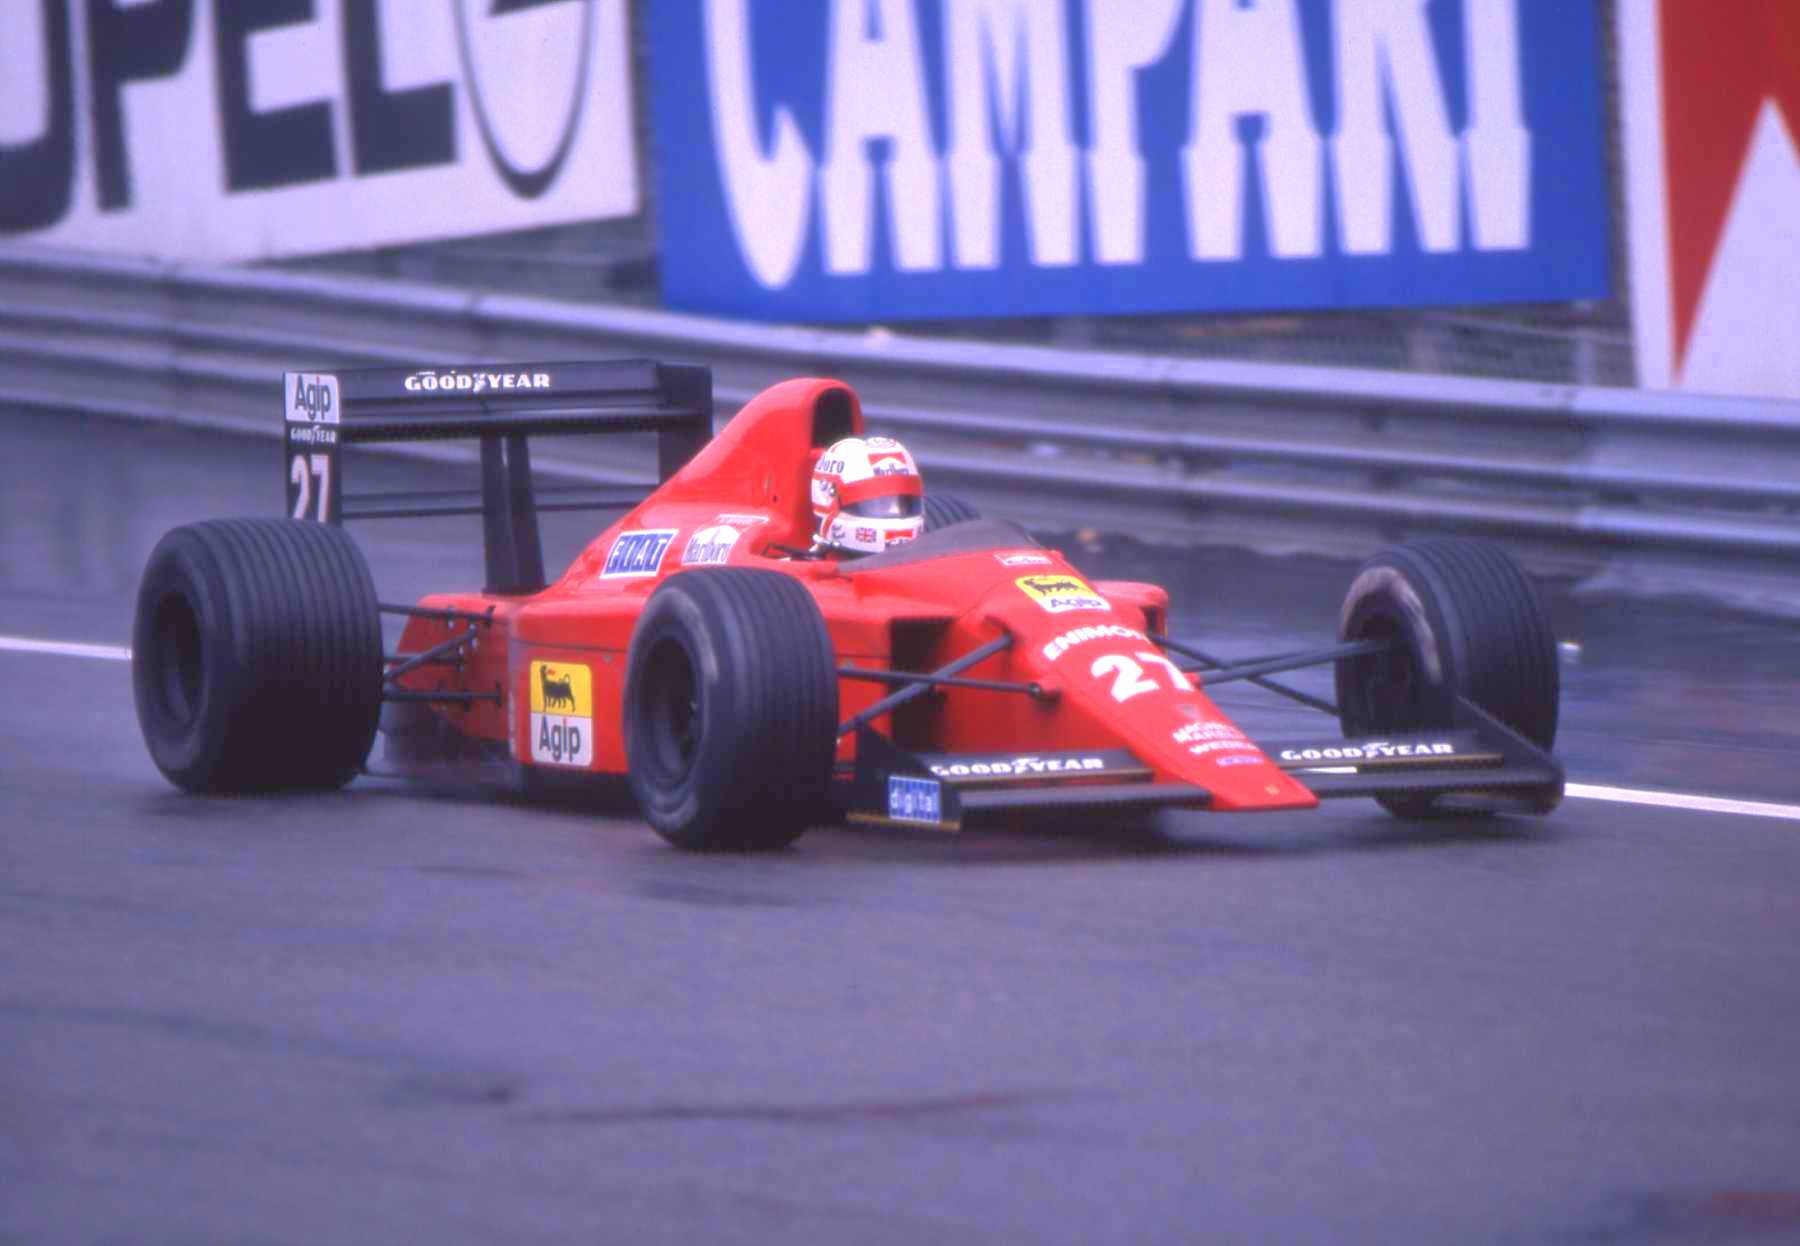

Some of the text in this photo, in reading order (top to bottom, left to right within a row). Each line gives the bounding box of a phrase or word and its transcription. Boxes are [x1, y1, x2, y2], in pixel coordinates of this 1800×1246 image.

[702, 0, 1532, 290] CAMPARI
[294, 376, 332, 420] Agip
[404, 371, 551, 393] GOODYEAR
[290, 425, 337, 445] GOODYEAR
[291, 454, 330, 523] 27
[609, 538, 669, 568] FIAT
[1043, 625, 1151, 661] ENIMO
[1090, 651, 1194, 703] 27
[539, 715, 581, 762] Agip
[1280, 742, 1453, 760] GOODYEAR
[930, 757, 1104, 776] GOODYEAR
